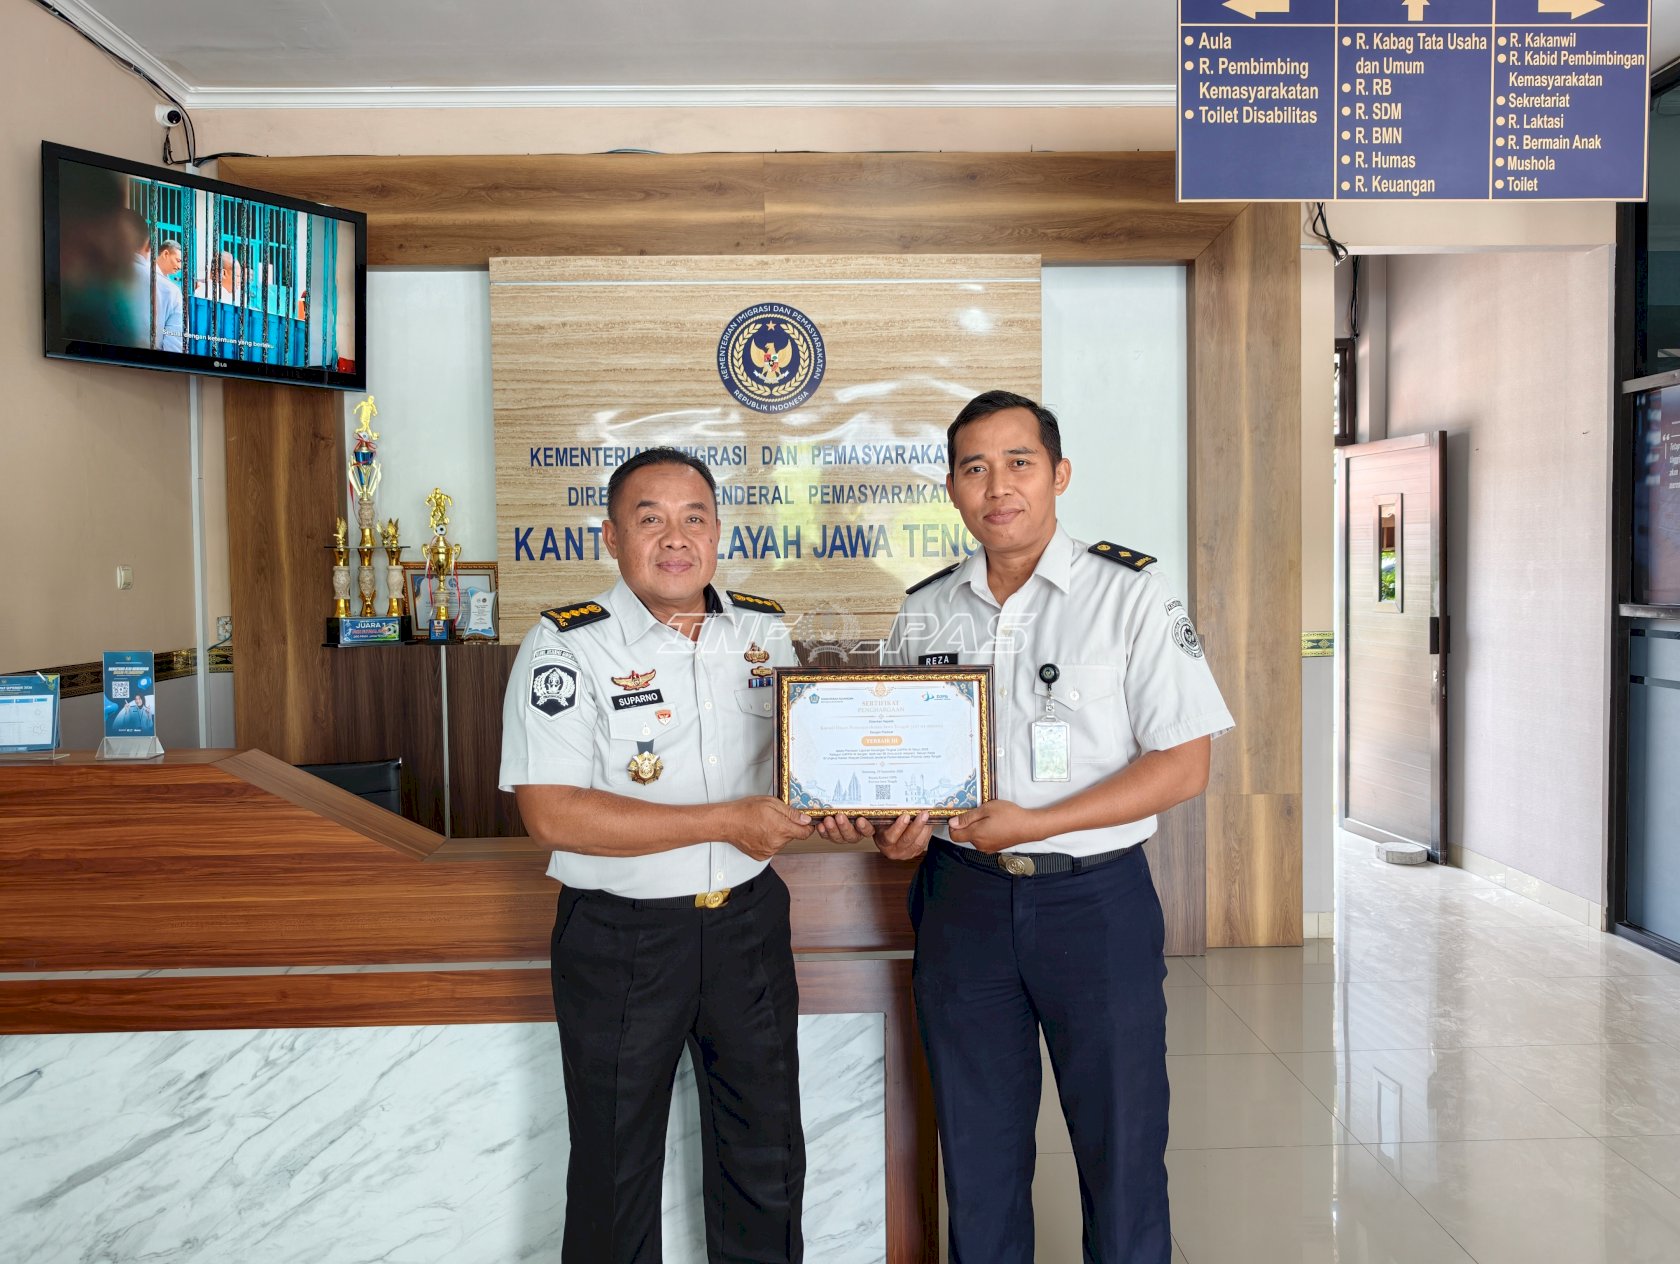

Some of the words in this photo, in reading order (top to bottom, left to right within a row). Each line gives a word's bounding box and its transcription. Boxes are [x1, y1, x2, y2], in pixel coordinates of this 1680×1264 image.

[1199, 32, 1232, 49] Aula
[1356, 33, 1369, 49] R.
[1374, 32, 1414, 54] Kabag
[1417, 33, 1443, 49] Tata
[1448, 33, 1487, 49] Usaha
[1510, 33, 1521, 47] R.
[1525, 32, 1576, 47] Kakanwil
[1199, 58, 1214, 74] R.
[1218, 57, 1309, 79] Pembimbing
[1356, 57, 1379, 74] dan
[1383, 57, 1424, 74] Umum
[1510, 51, 1521, 65] R.
[1525, 51, 1557, 65] Kabid
[1561, 51, 1644, 69] Pembimbingan
[1356, 79, 1369, 95] R.
[1373, 79, 1392, 95] RB
[1509, 72, 1602, 90] Kemasyarakatan
[1199, 82, 1318, 103] Kemasyarakatan
[1508, 93, 1570, 108] Sekretariat
[1199, 107, 1238, 123] Toilet
[1242, 107, 1317, 123] Disabilitas
[1355, 103, 1368, 119] R.
[1372, 103, 1402, 119] SDM
[1508, 114, 1520, 128] R.
[1523, 114, 1564, 128] Laktasi
[1355, 127, 1368, 144] R.
[1372, 127, 1402, 144] BMN
[1508, 135, 1520, 149] R.
[1523, 135, 1569, 149] Bermain
[1572, 134, 1601, 149] Anak
[1355, 152, 1368, 168] R.
[1372, 151, 1416, 168] Humas
[1507, 156, 1555, 170] Mushola
[1355, 176, 1368, 192] R.
[1372, 175, 1435, 196] Keuangan
[1507, 177, 1538, 191] Toilet
[719, 322, 738, 380] KEMENTERIAN
[736, 305, 771, 324] IMIGRASI
[773, 305, 791, 315] DAN
[791, 311, 823, 380] PEMASYARAKATAN
[733, 389, 768, 411] REPUBLIK
[769, 390, 809, 411] INDONESIA
[762, 446, 797, 465] DAN
[809, 484, 951, 504] PEMASYARAKAT
[514, 527, 602, 561] KANT
[812, 524, 893, 558] JAWA
[902, 524, 979, 557] TENG
[925, 655, 950, 666] REZA
[618, 692, 658, 706] SUPARNO
